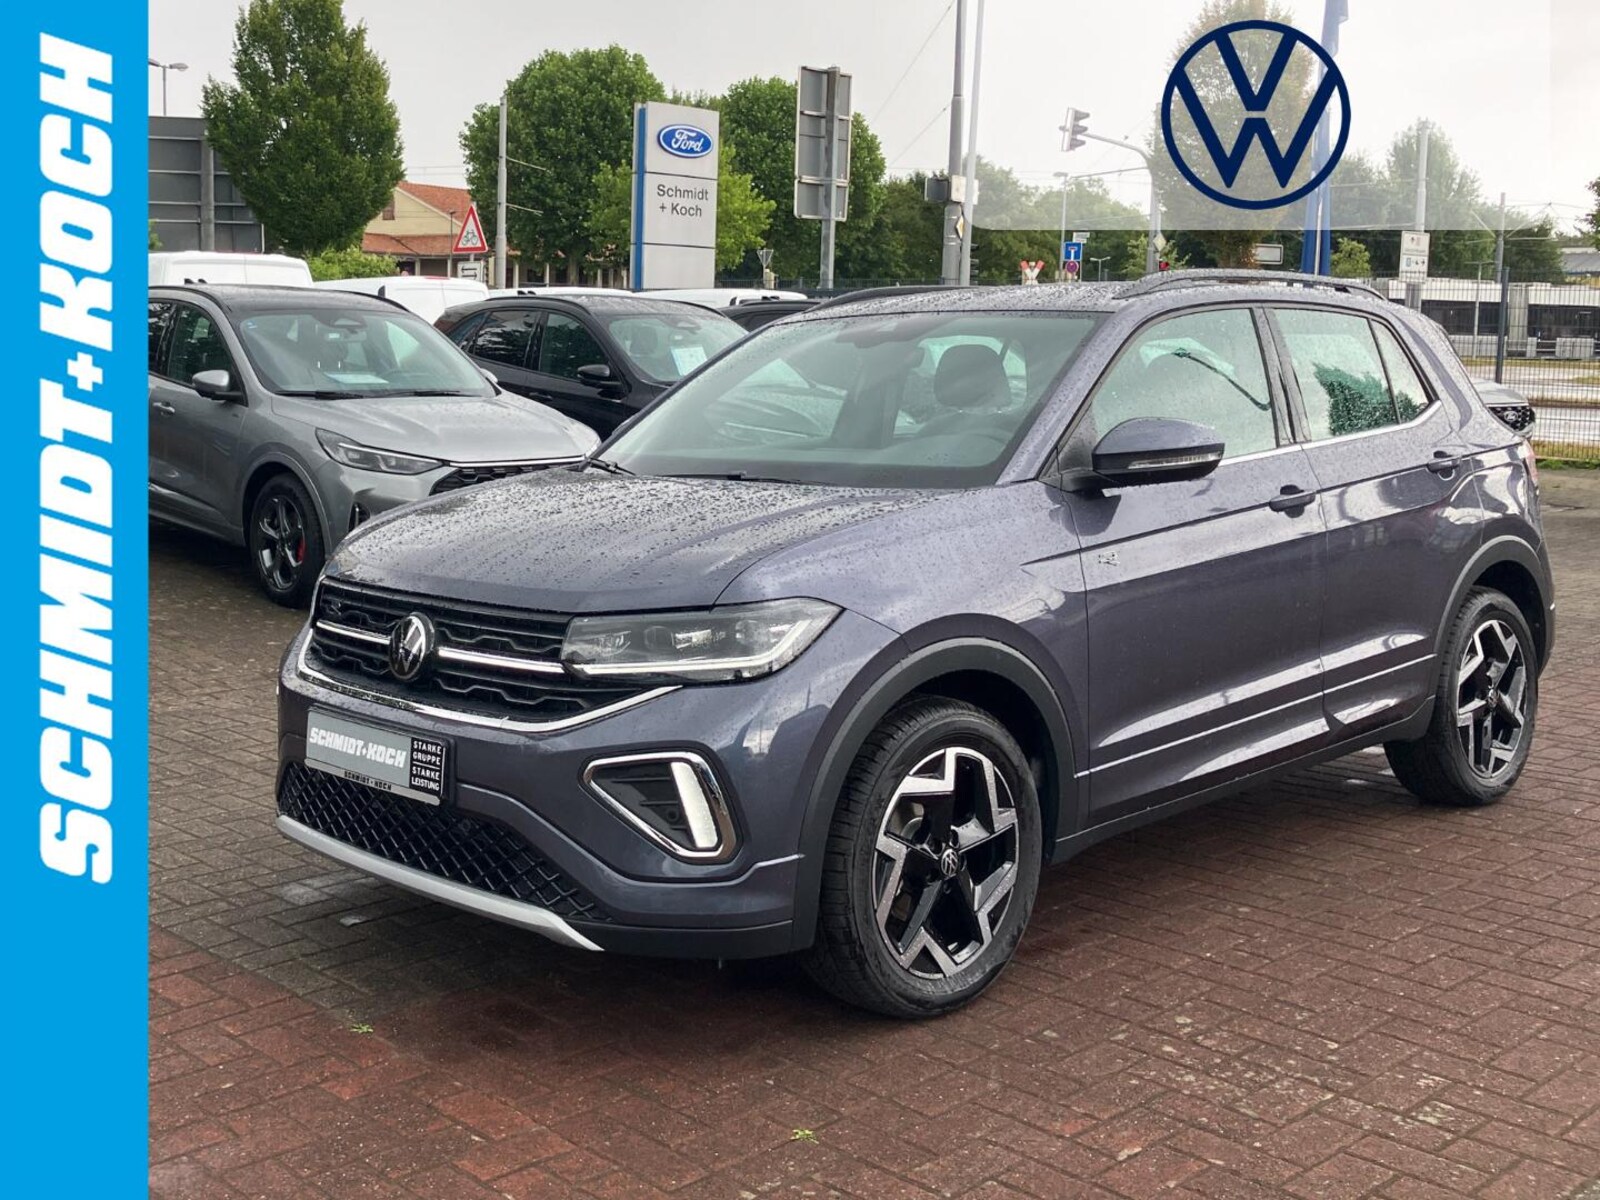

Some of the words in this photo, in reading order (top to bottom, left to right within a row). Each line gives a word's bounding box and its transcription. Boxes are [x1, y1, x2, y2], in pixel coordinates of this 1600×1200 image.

[671, 129, 704, 152] Ford
[657, 184, 709, 201] Schmidt
[671, 202, 703, 218] Koch
[413, 740, 442, 755] STARKE
[412, 751, 441, 765] GRUPPE
[412, 766, 440, 781] STARKE
[411, 776, 440, 791] LEISTUNG
